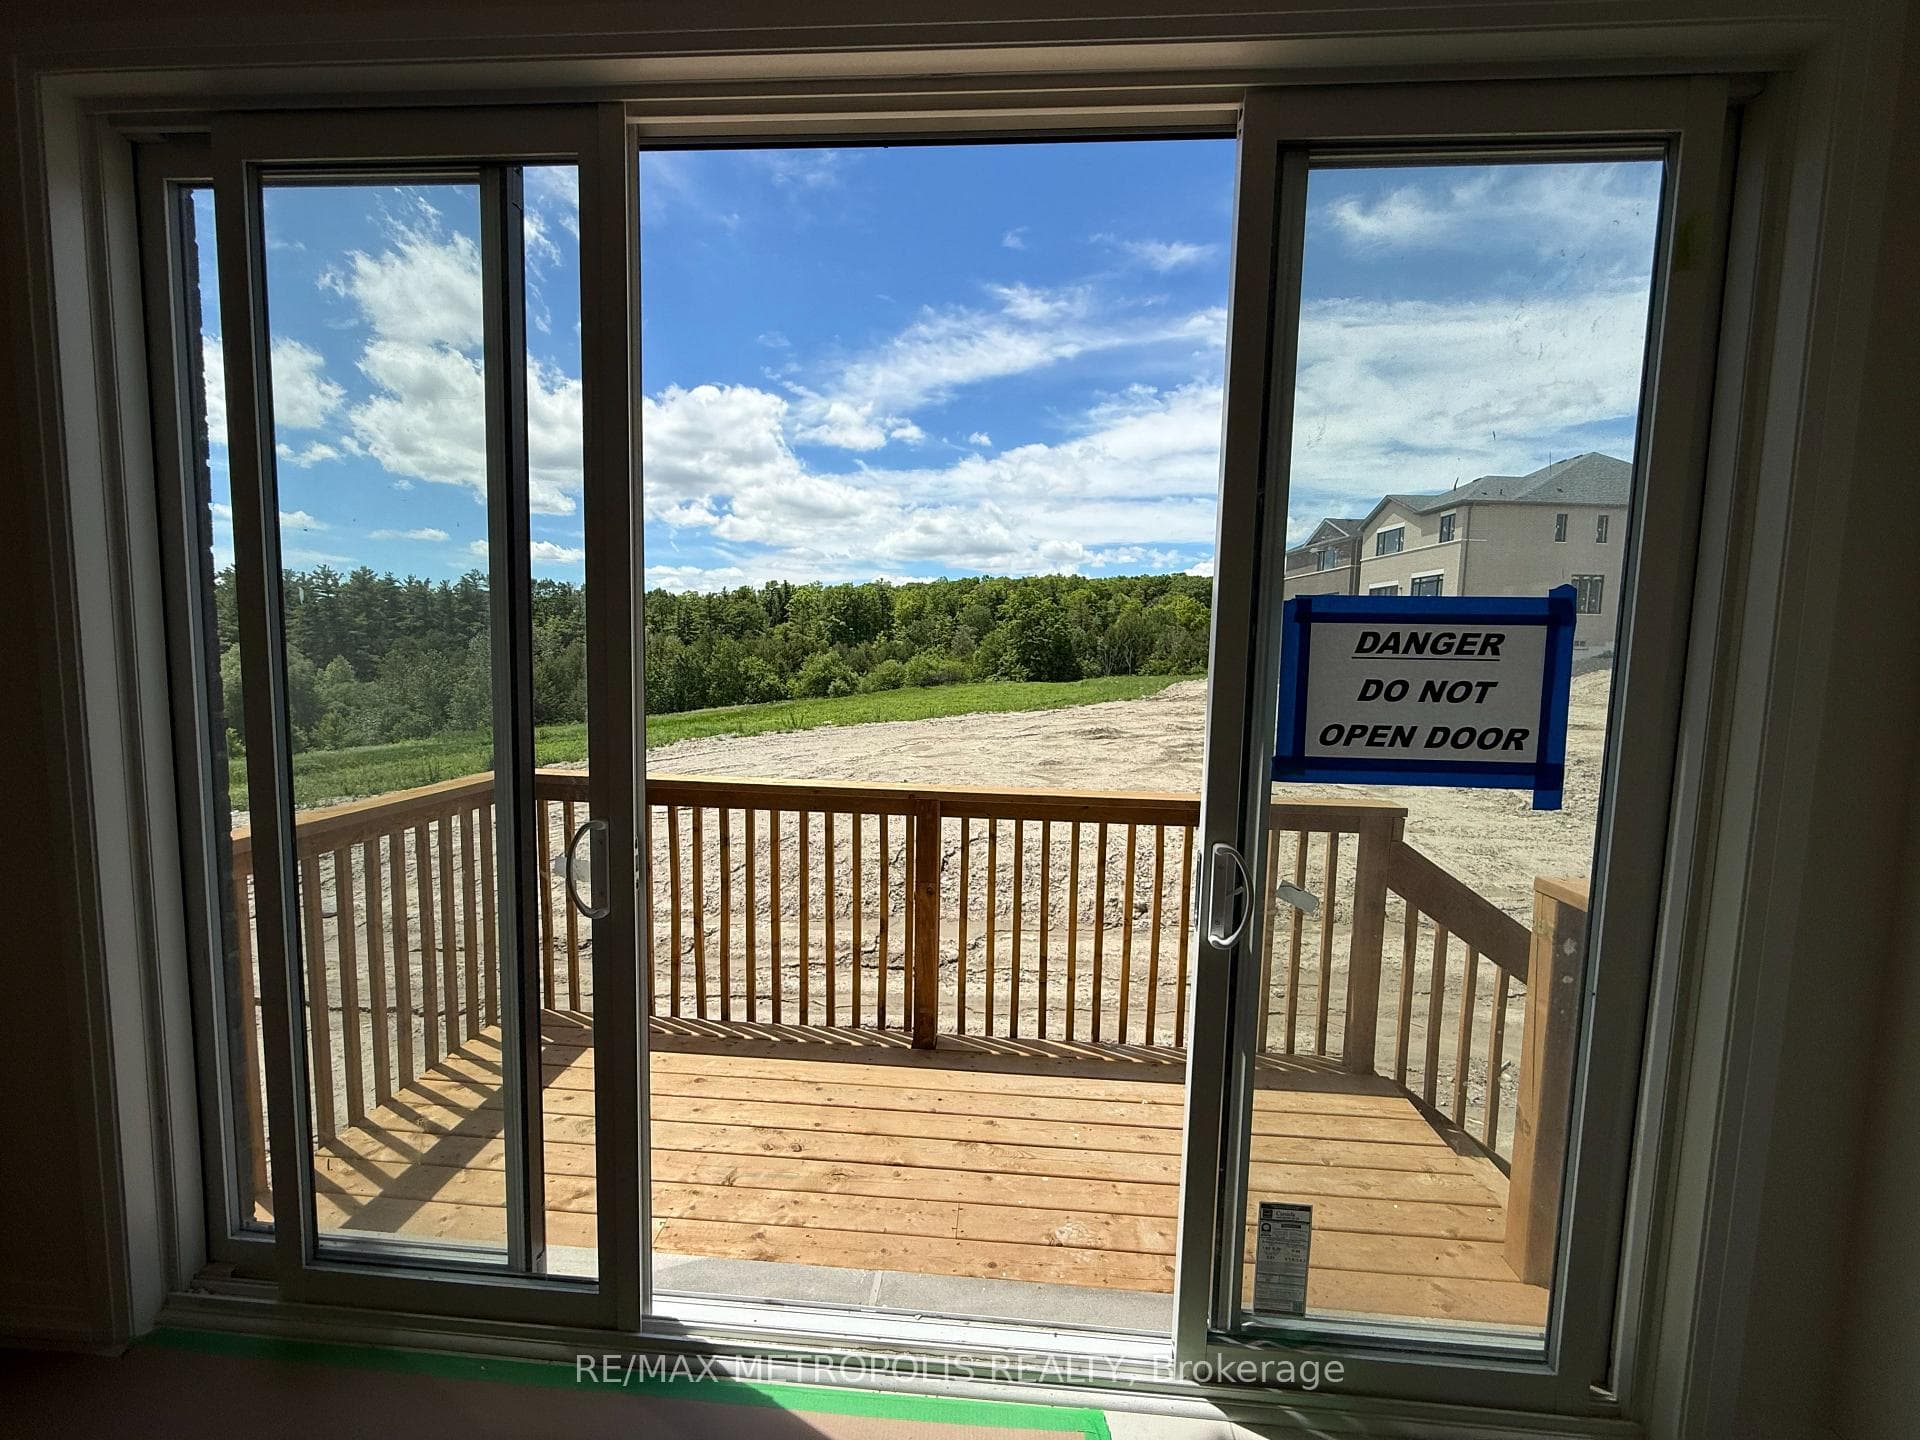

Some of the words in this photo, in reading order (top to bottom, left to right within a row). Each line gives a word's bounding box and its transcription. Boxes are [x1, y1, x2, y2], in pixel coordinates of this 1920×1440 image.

[1354, 631, 1506, 657] DANGER
[1356, 678, 1410, 702] DO
[1417, 680, 1498, 704] NOT
[1318, 724, 1418, 748] OPEN
[1423, 726, 1530, 751] DOOR
